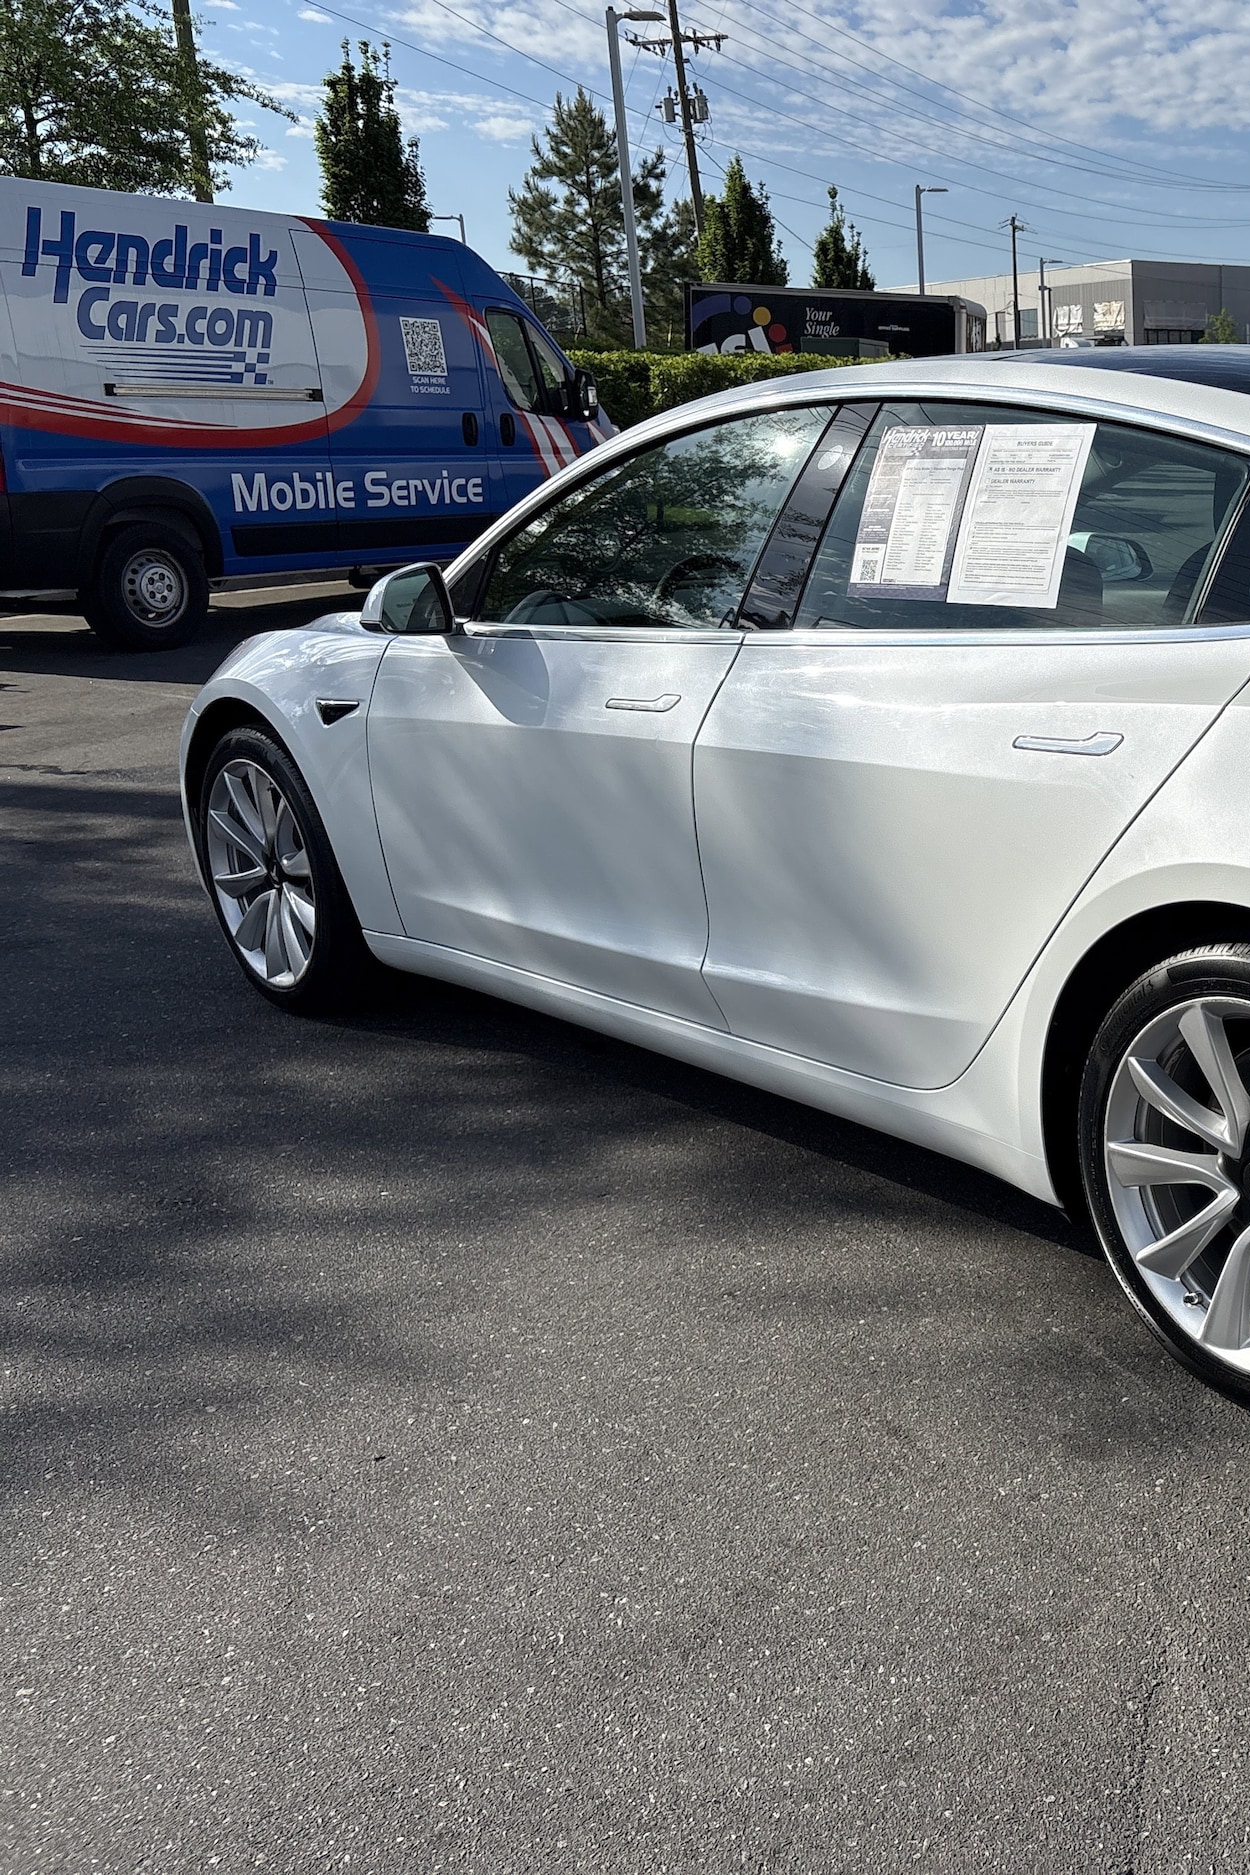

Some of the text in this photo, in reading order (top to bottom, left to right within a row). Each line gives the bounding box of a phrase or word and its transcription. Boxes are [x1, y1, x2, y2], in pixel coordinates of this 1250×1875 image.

[21, 206, 278, 304] Hendrick
[77, 286, 273, 349] Cars.com
[805, 307, 833, 321] Your
[804, 322, 840, 338] Single
[412, 376, 446, 385] SCAN HERE
[410, 385, 451, 394] TO SCHEDULE
[931, 431, 947, 447] 10
[231, 470, 484, 513] Mobile Service
